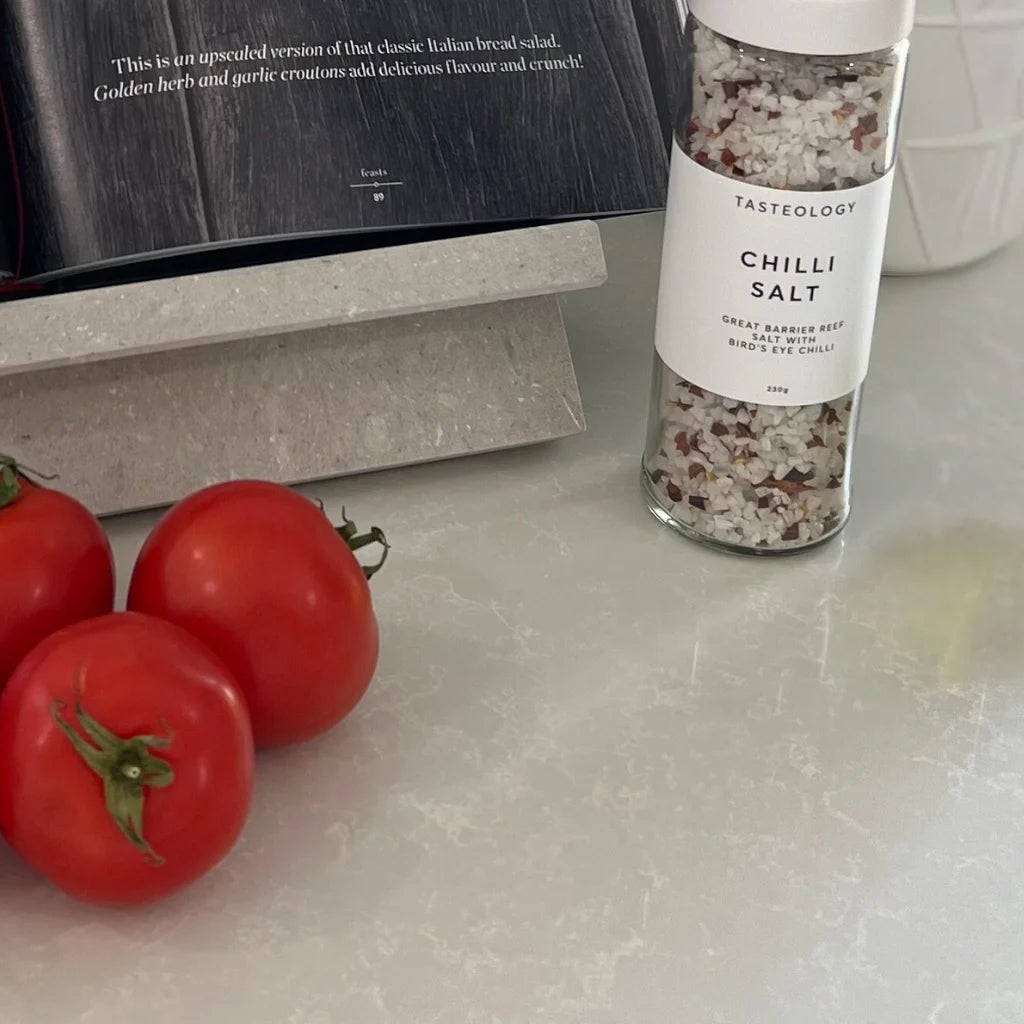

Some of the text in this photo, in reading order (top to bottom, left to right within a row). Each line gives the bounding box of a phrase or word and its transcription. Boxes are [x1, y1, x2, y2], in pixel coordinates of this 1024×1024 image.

[112, 33, 561, 75] This is an upscaled version of that classic Italian bread salad.
[94, 54, 585, 102] Golden herb and garlic croutons add delicious flavour and crunch!
[374, 192, 384, 202] 89
[735, 195, 856, 218] TASTEOLOGY
[741, 251, 834, 274] CHILLI
[751, 282, 819, 302] SALT
[722, 315, 844, 334] GREAT BARRIER REEF
[729, 338, 834, 355] BIRD'S EYE CHILLI
[752, 333, 816, 344] SALT WITH
[767, 386, 788, 394] 230g
